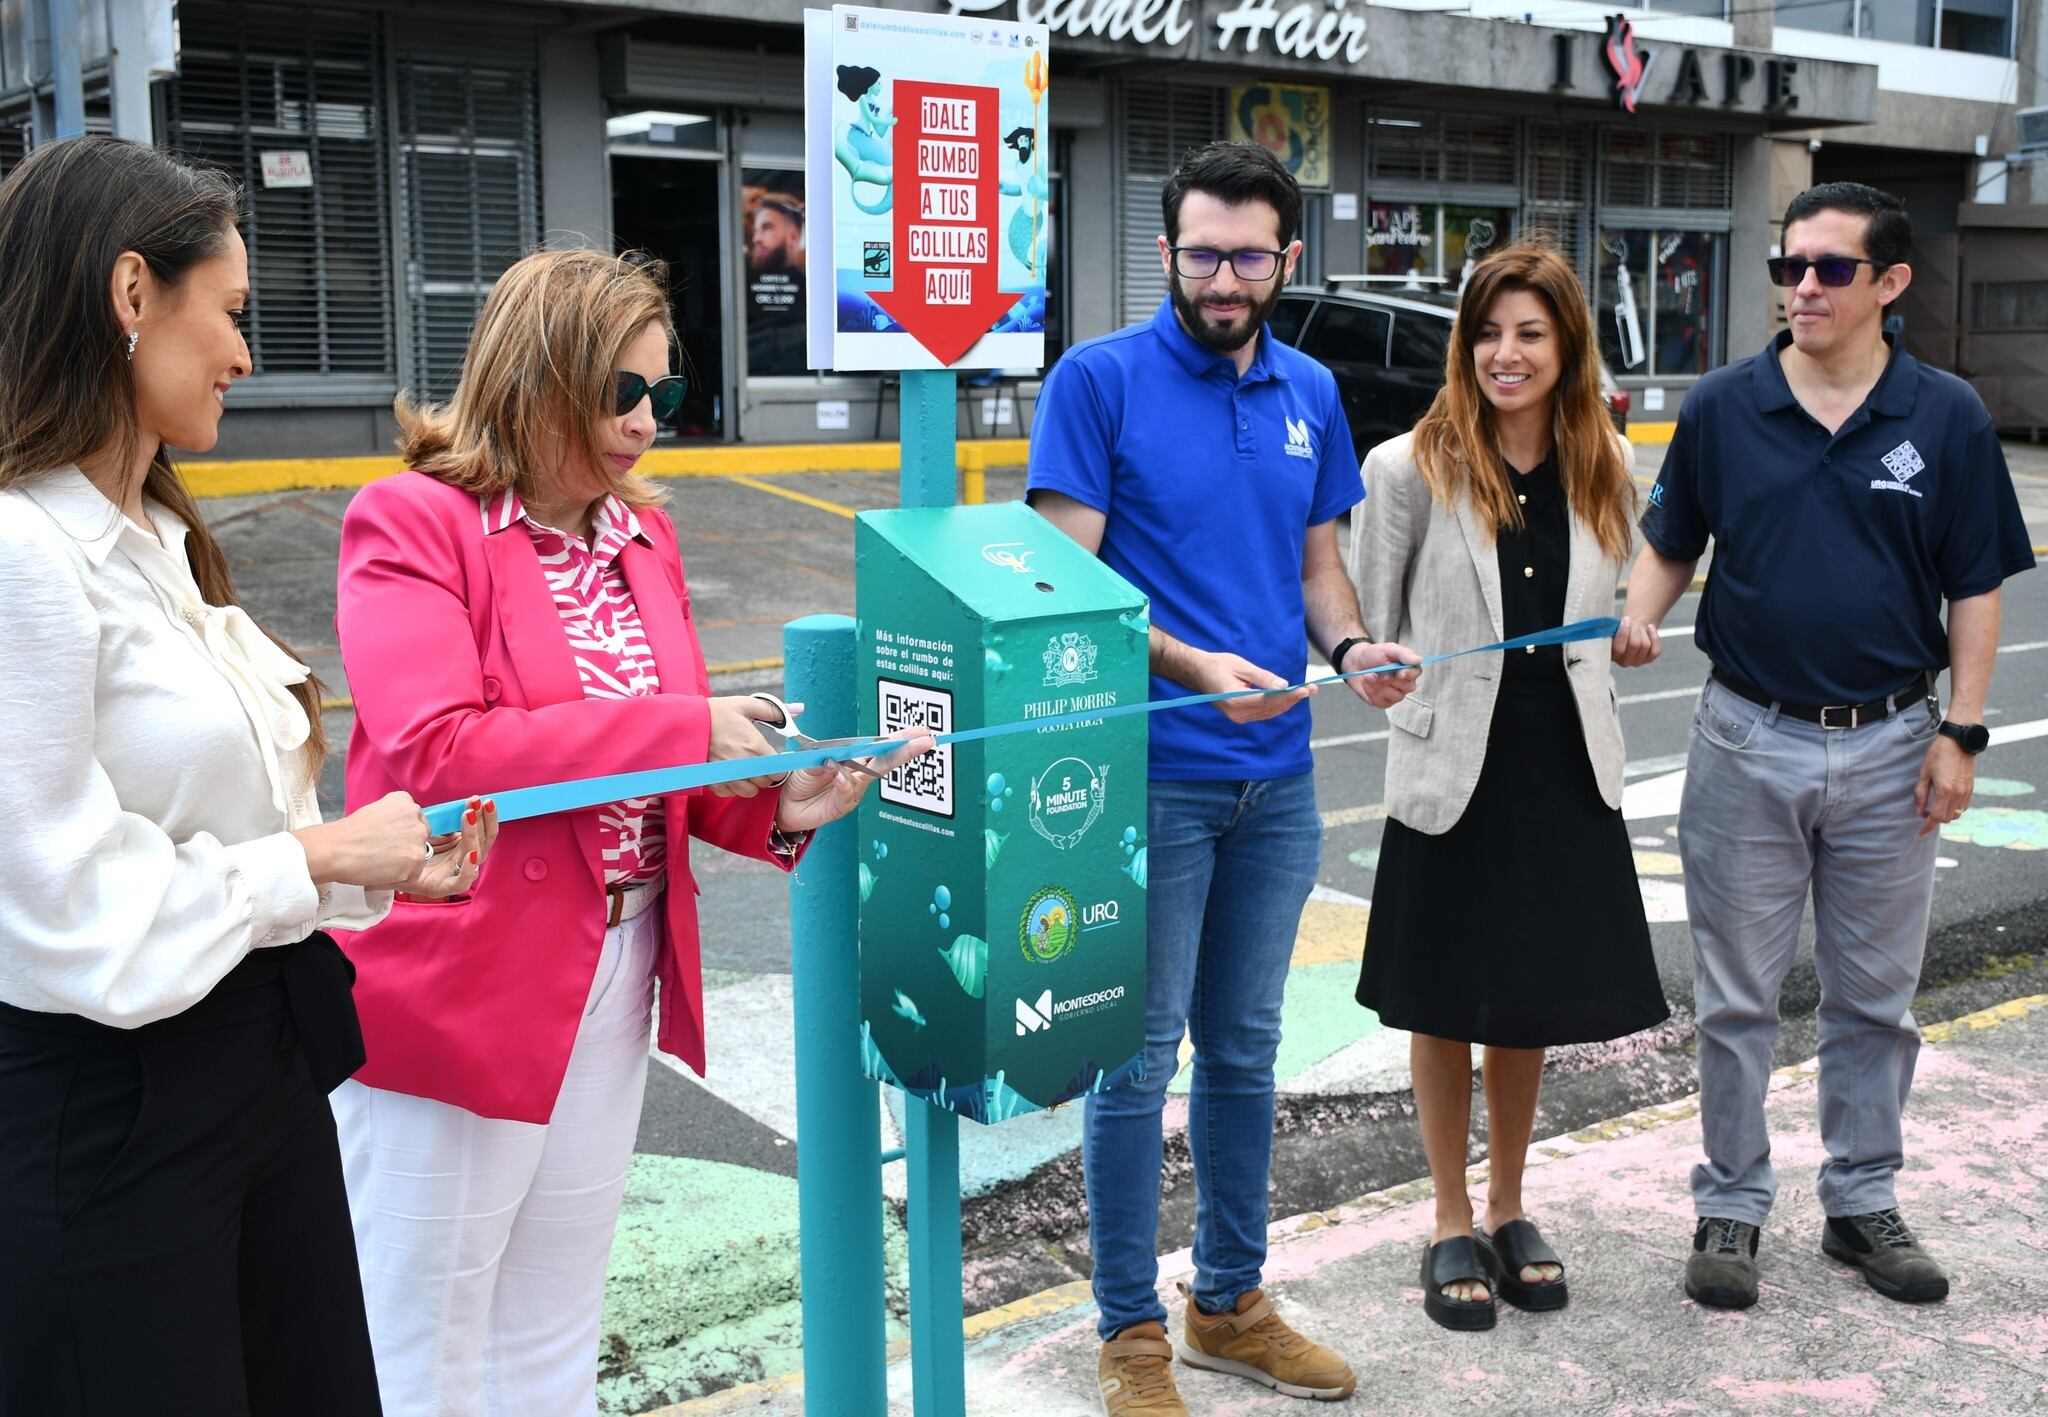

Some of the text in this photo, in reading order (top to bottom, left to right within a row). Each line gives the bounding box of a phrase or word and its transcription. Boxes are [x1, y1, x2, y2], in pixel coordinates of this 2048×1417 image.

[860, 20, 967, 38] dalerumboatuscolillas.com
[1217, 0, 1369, 63] Hair
[1554, 35, 1576, 90] I
[923, 101, 969, 131] ¡DALE
[1303, 92, 1319, 180] SOMOS
[920, 144, 977, 175] RUMBO
[922, 188, 969, 216] A TUS
[911, 229, 986, 258] COLILLAS
[927, 270, 970, 304] AQUÍ!
[876, 629, 953, 653] Más información
[876, 646, 954, 667] sobre el rumbo de
[876, 659, 897, 671] estas
[898, 663, 929, 677] colillas
[1024, 691, 1117, 720] PHILIP MORRIS
[1062, 776, 1071, 791] 5
[1046, 789, 1087, 807] MINUTE
[1046, 801, 1088, 815] FOUNDATION
[1082, 900, 1119, 925] URQ
[1053, 986, 1124, 1015] MONTESDEOCA
[1058, 1002, 1118, 1021] GOBIERNO LOCAL
